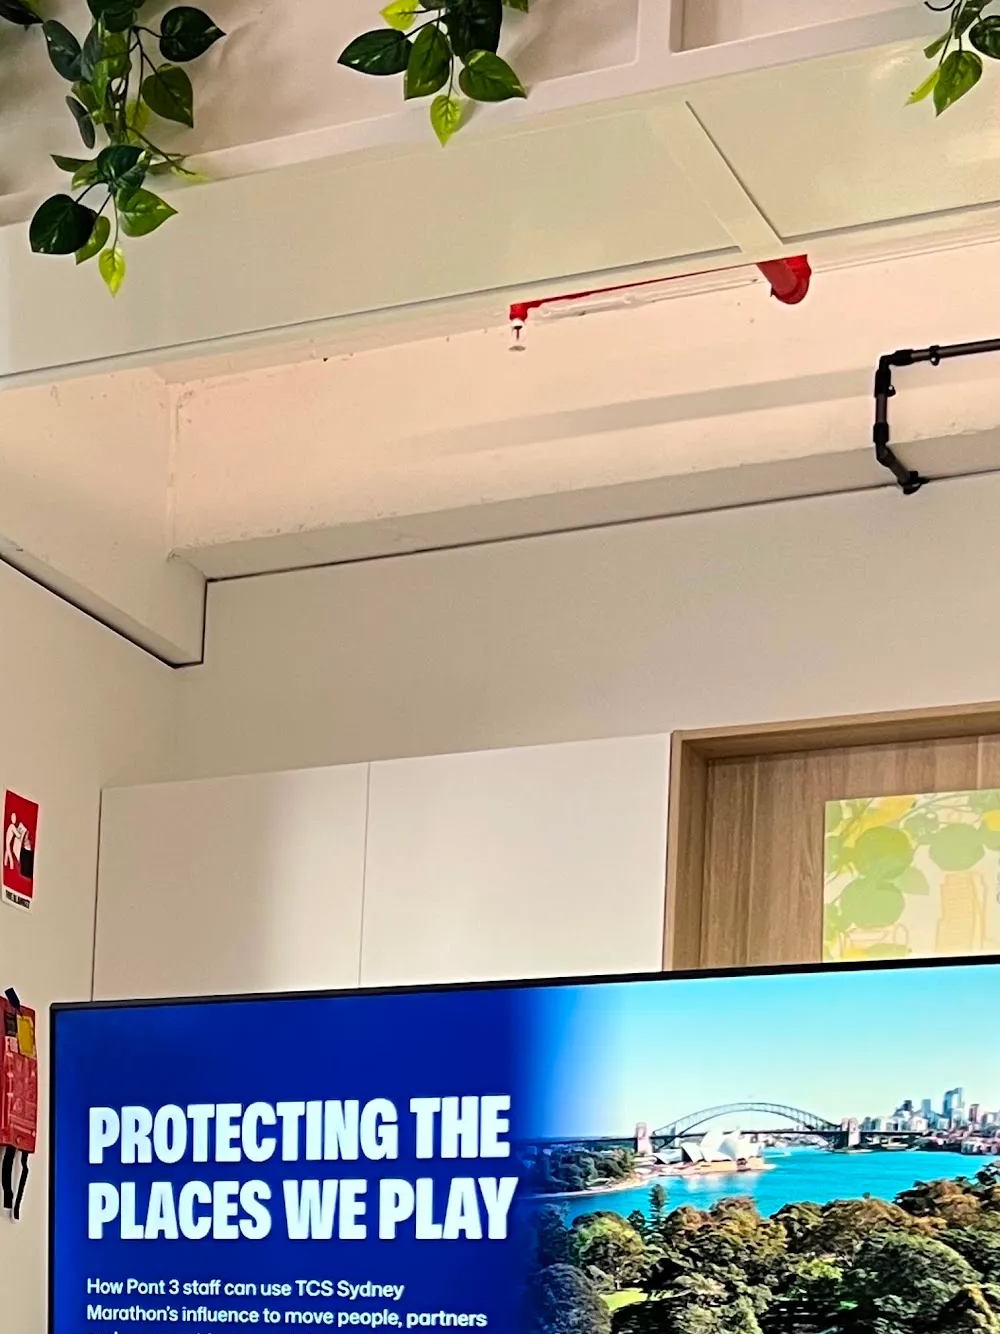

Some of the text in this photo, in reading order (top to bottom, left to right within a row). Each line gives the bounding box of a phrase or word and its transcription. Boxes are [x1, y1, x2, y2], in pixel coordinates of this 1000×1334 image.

[89, 1095, 511, 1163] PROTECTING THE
[88, 1177, 519, 1239] PLACES WE PLAY
[87, 1278, 405, 1301] How Pont 3 staff can use TCS Sydney
[86, 1305, 488, 1329] Marathon's influence to move people, partners
